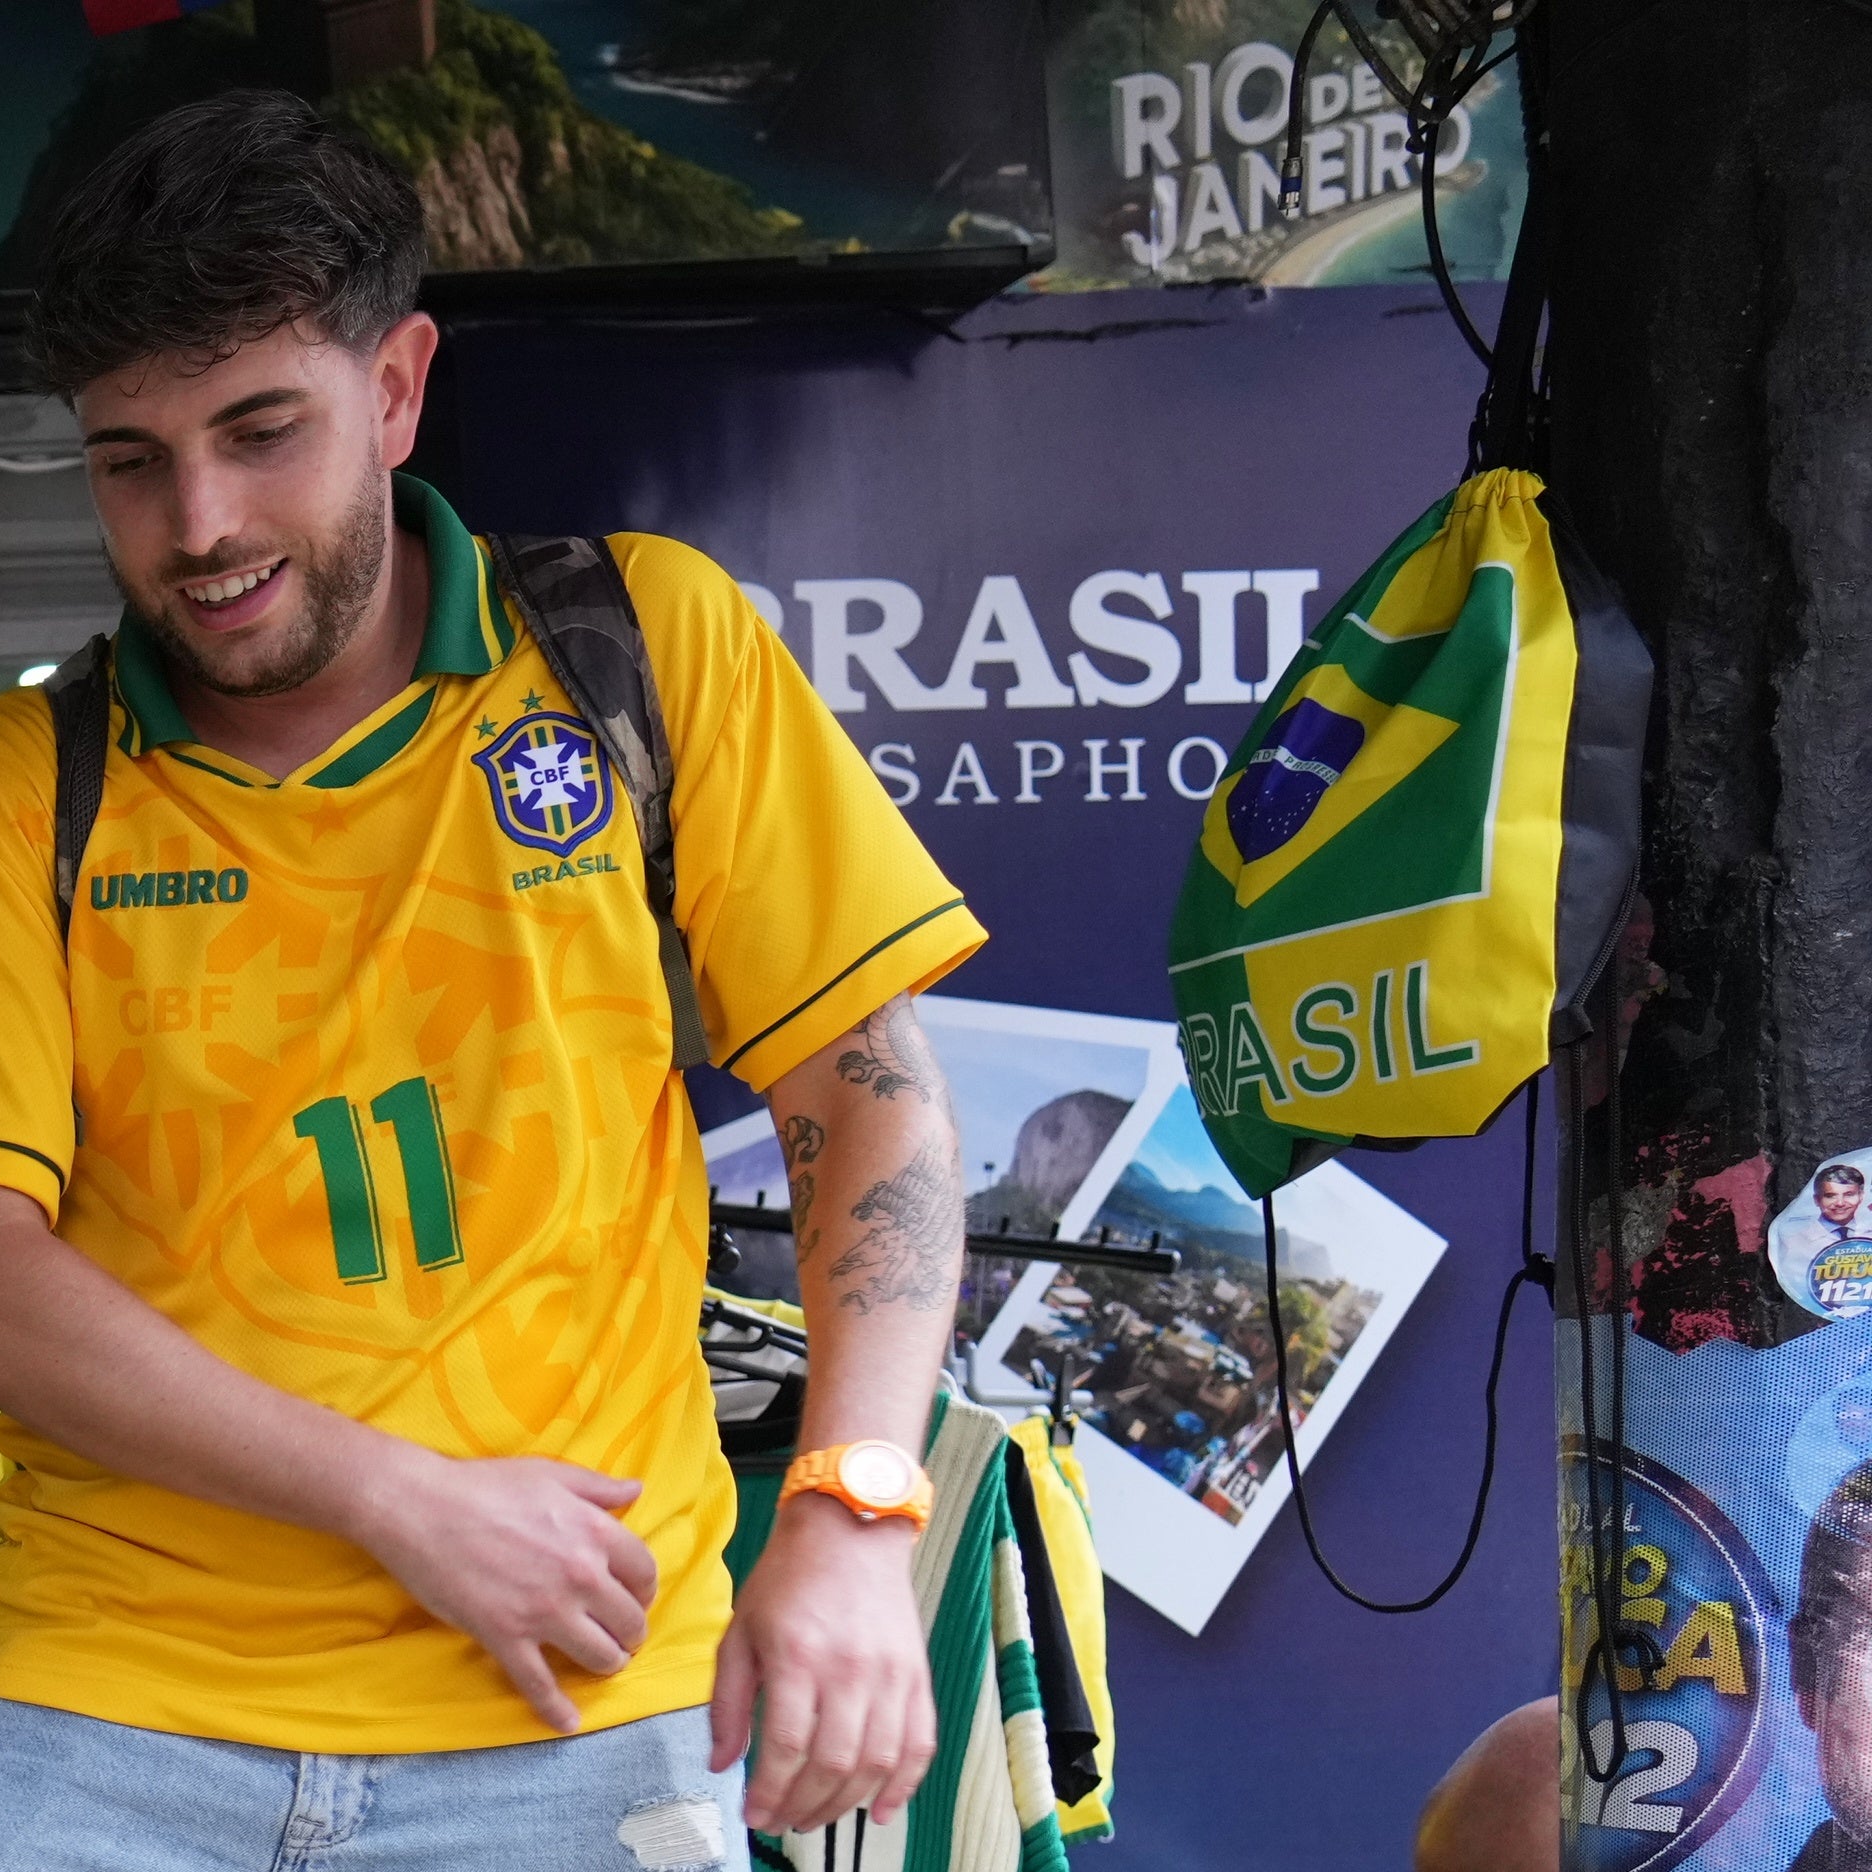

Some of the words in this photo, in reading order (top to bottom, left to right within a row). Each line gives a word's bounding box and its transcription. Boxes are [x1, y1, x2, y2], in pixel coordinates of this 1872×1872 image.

[1111, 42, 1296, 180] RIO
[1309, 60, 1384, 124] DE
[529, 766, 570, 787] CBF
[90, 867, 250, 911] UMBRO
[512, 853, 622, 892] BRASIL
[118, 984, 234, 1038] CBF
[293, 1075, 465, 1286] 11
